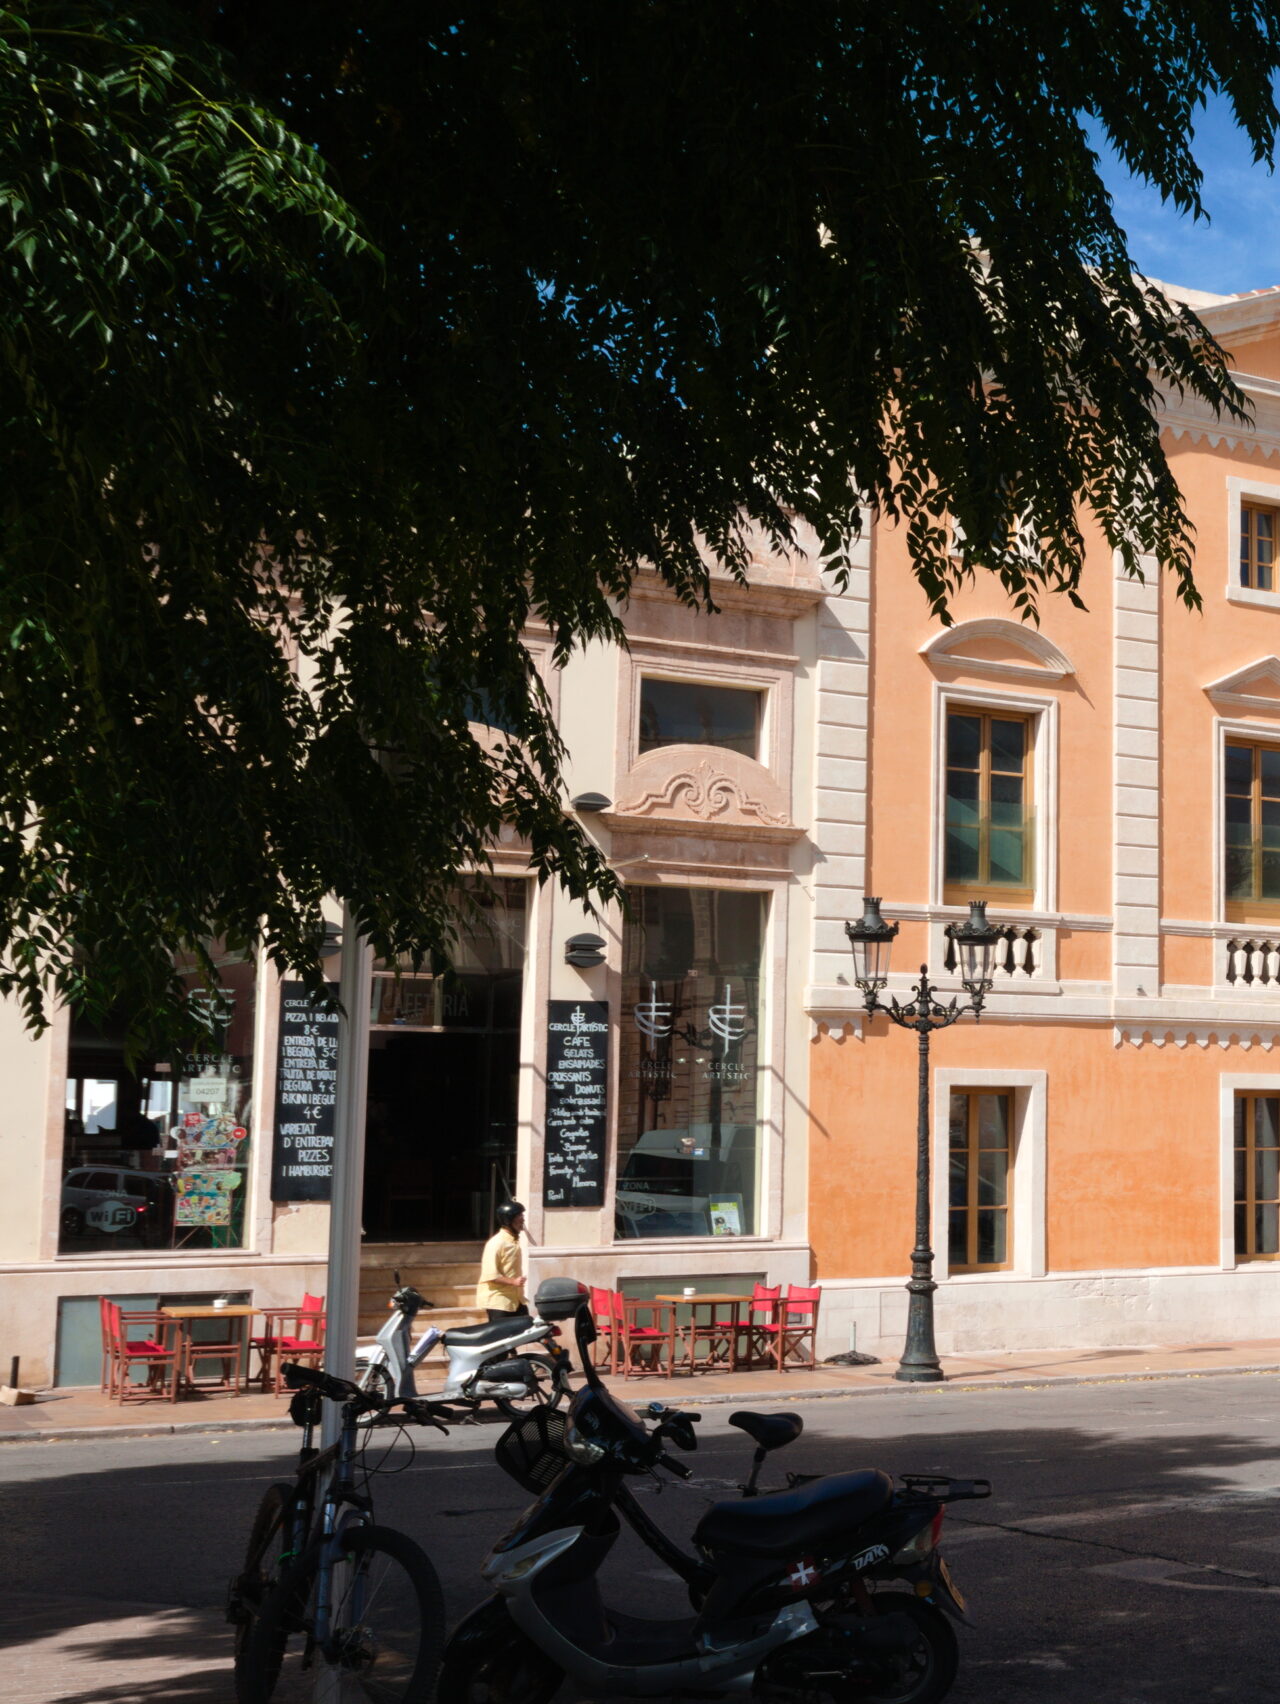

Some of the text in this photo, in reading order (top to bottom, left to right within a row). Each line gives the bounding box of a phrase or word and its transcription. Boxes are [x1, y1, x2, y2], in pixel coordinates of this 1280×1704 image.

[284, 1000, 309, 1008] CERCLE
[285, 1012, 307, 1022] PIZZA
[548, 1022, 576, 1032] CERCLE
[317, 1037, 328, 1047] DE
[329, 1038, 338, 1048] LL
[286, 1046, 317, 1058] BEGUDA
[563, 1049, 595, 1058] GELATS
[185, 1053, 234, 1063] CERCLE
[319, 1059, 329, 1070] DE
[558, 1059, 606, 1070] ENSAIMADES
[707, 1062, 745, 1071] CERCLE
[283, 1080, 313, 1092] BEGUDA
[282, 1092, 308, 1105] BIKINI
[280, 1123, 317, 1135] VARIETAT
[297, 1149, 330, 1162] PIZZES
